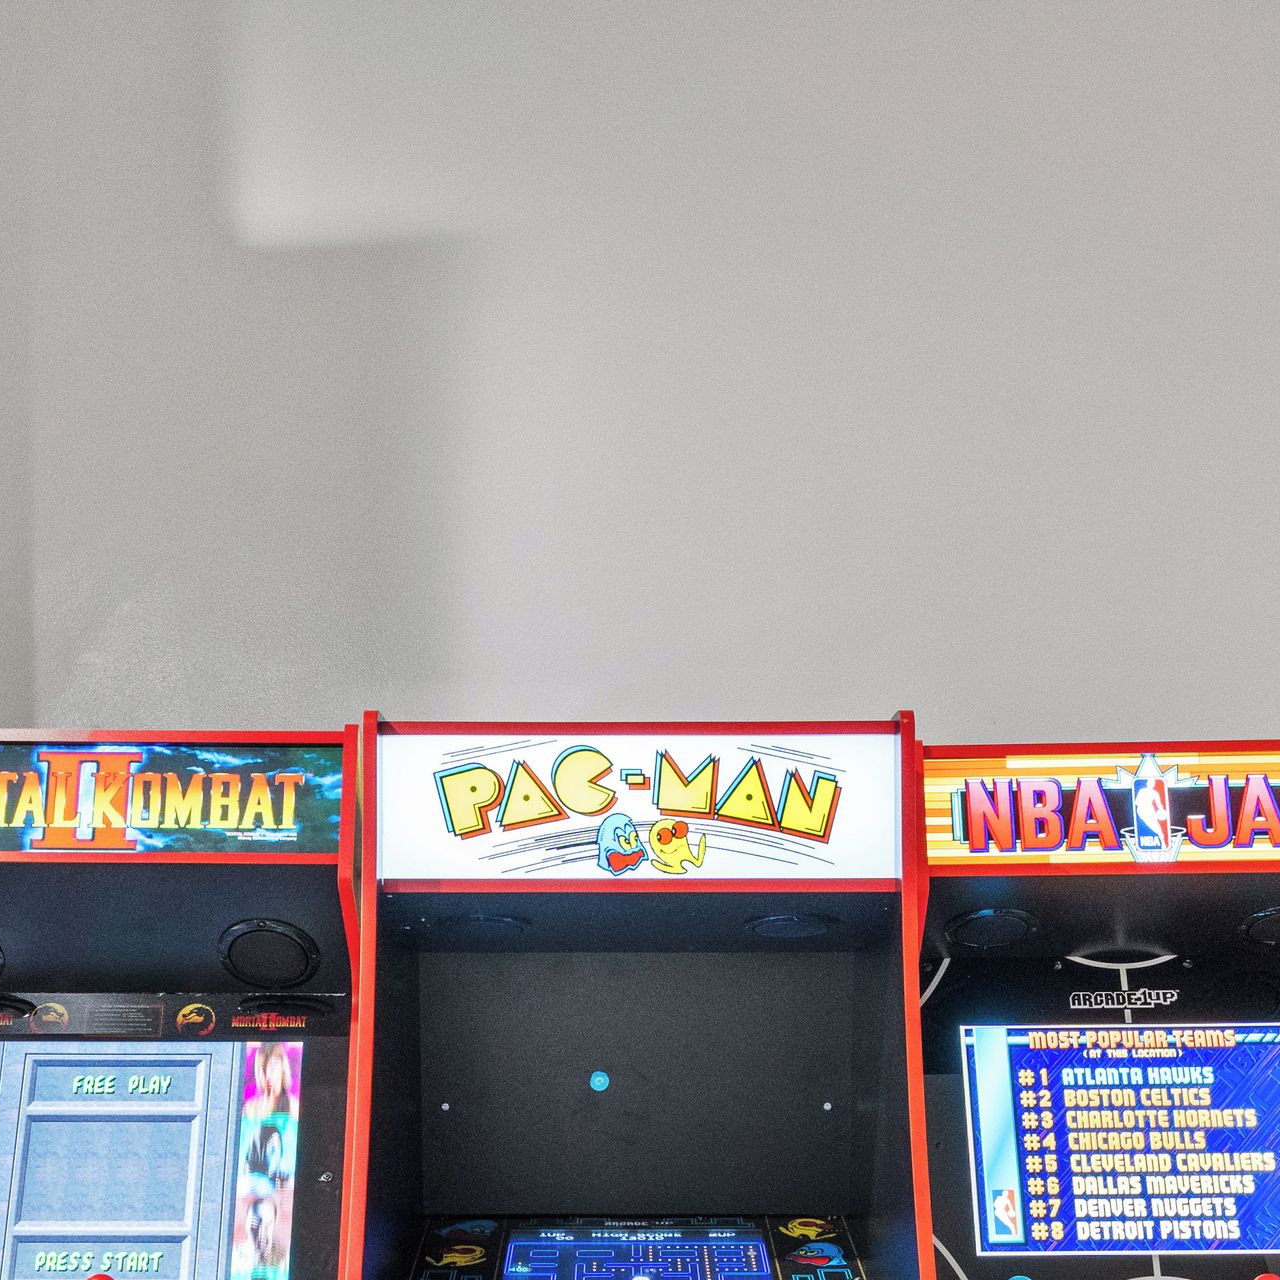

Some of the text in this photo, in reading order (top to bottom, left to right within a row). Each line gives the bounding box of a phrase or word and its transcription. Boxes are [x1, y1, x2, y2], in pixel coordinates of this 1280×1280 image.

[86, 772, 305, 830] KOMBAT
[434, 744, 841, 844] PAC-MAN
[965, 777, 1124, 852] NBA
[1138, 836, 1160, 847] NBA
[1028, 1029, 1237, 1049] MOST POPULAR TEAMS
[1107, 1049, 1129, 1058] THIS
[72, 1075, 172, 1095] FREE PLAY
[1061, 1067, 1143, 1086] ATLANTA
[1147, 1066, 1215, 1086] HAWKS
[1020, 1087, 1212, 1108] #2 BOSTON CELTICS
[1022, 1108, 1258, 1130] #3 CHARLOTTE HORNETS
[1023, 1131, 1207, 1151] #4 CHICAGO BULLS
[1025, 1152, 1276, 1173] #5 CLEVELAND CAVALIERS
[1027, 1174, 1256, 1196] #6 DALLAS MAVERICKS
[1029, 1197, 1237, 1218] #7 DENVER NUGGETS
[1031, 1219, 1241, 1241] #8 DETROIT PISTONS
[34, 1252, 164, 1272] PRESS START
